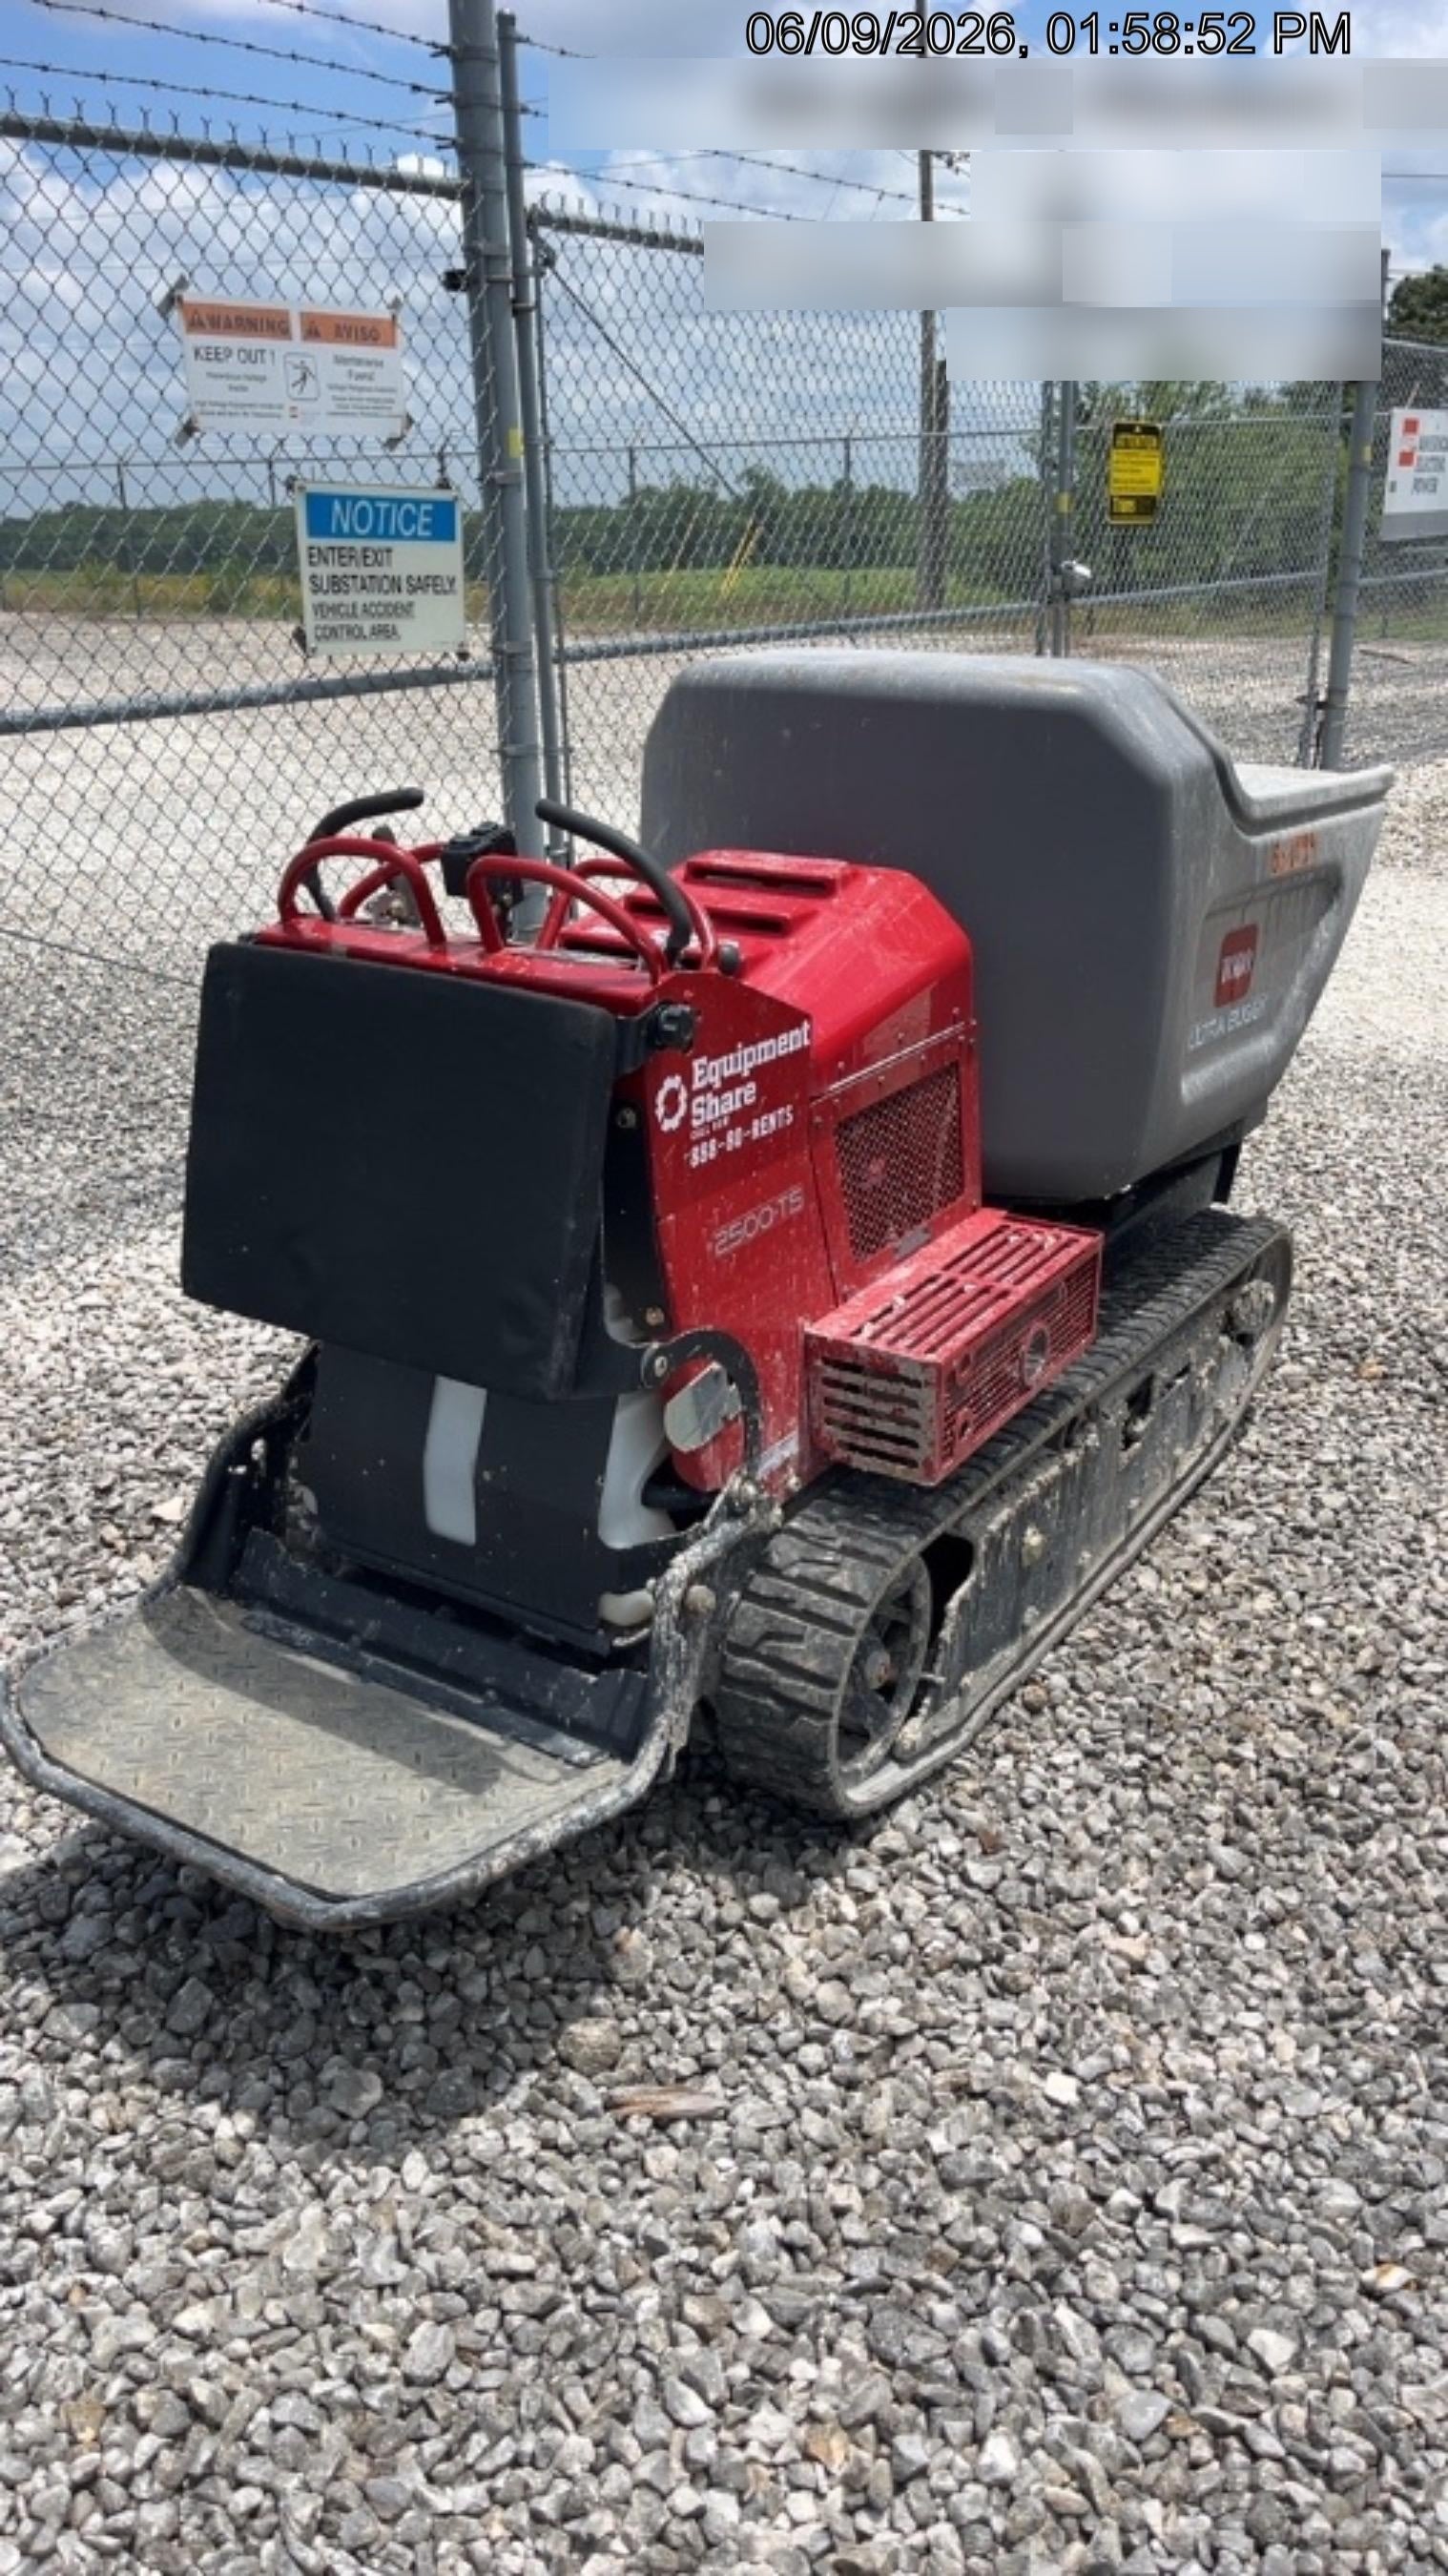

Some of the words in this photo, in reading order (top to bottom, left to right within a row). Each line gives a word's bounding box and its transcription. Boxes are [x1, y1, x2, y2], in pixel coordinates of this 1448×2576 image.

[206, 313, 290, 336] WARNING
[335, 324, 381, 343] AVISO
[195, 346, 233, 363] KEEP
[238, 348, 266, 365] OUT
[331, 498, 433, 536] NOTICE
[307, 546, 393, 568] ENTER/EXIT
[309, 574, 402, 595] SUBSTATION
[312, 601, 359, 618] VEHICLE
[314, 624, 367, 642] CONTROL
[692, 1019, 810, 1091] Equipment
[691, 1081, 756, 1129] Share
